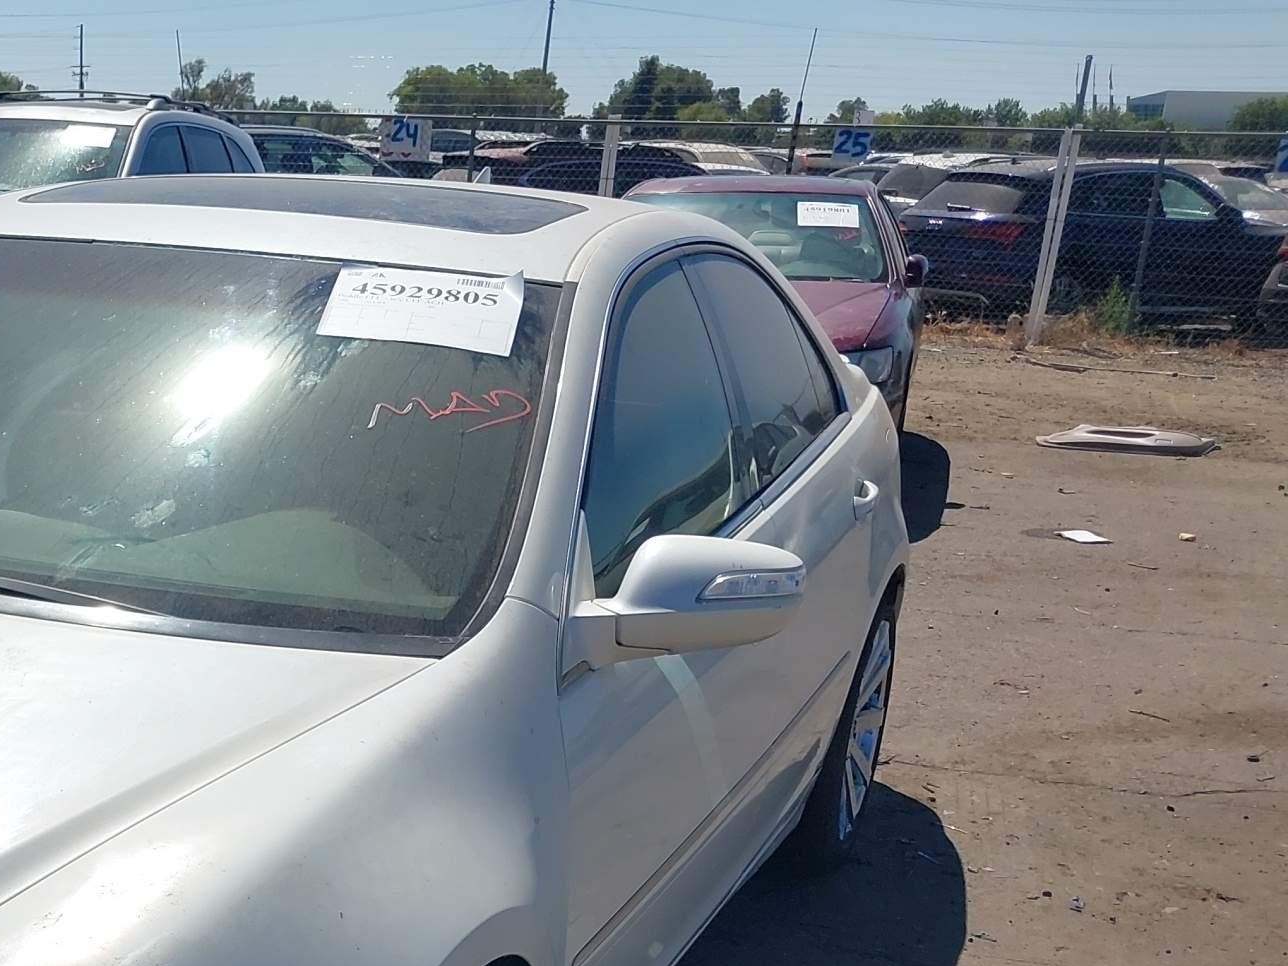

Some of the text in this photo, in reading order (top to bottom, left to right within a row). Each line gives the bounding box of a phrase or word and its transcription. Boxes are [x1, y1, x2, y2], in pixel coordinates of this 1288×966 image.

[391, 117, 419, 148] 24
[834, 130, 871, 158] 25
[351, 281, 501, 308] 45929805
